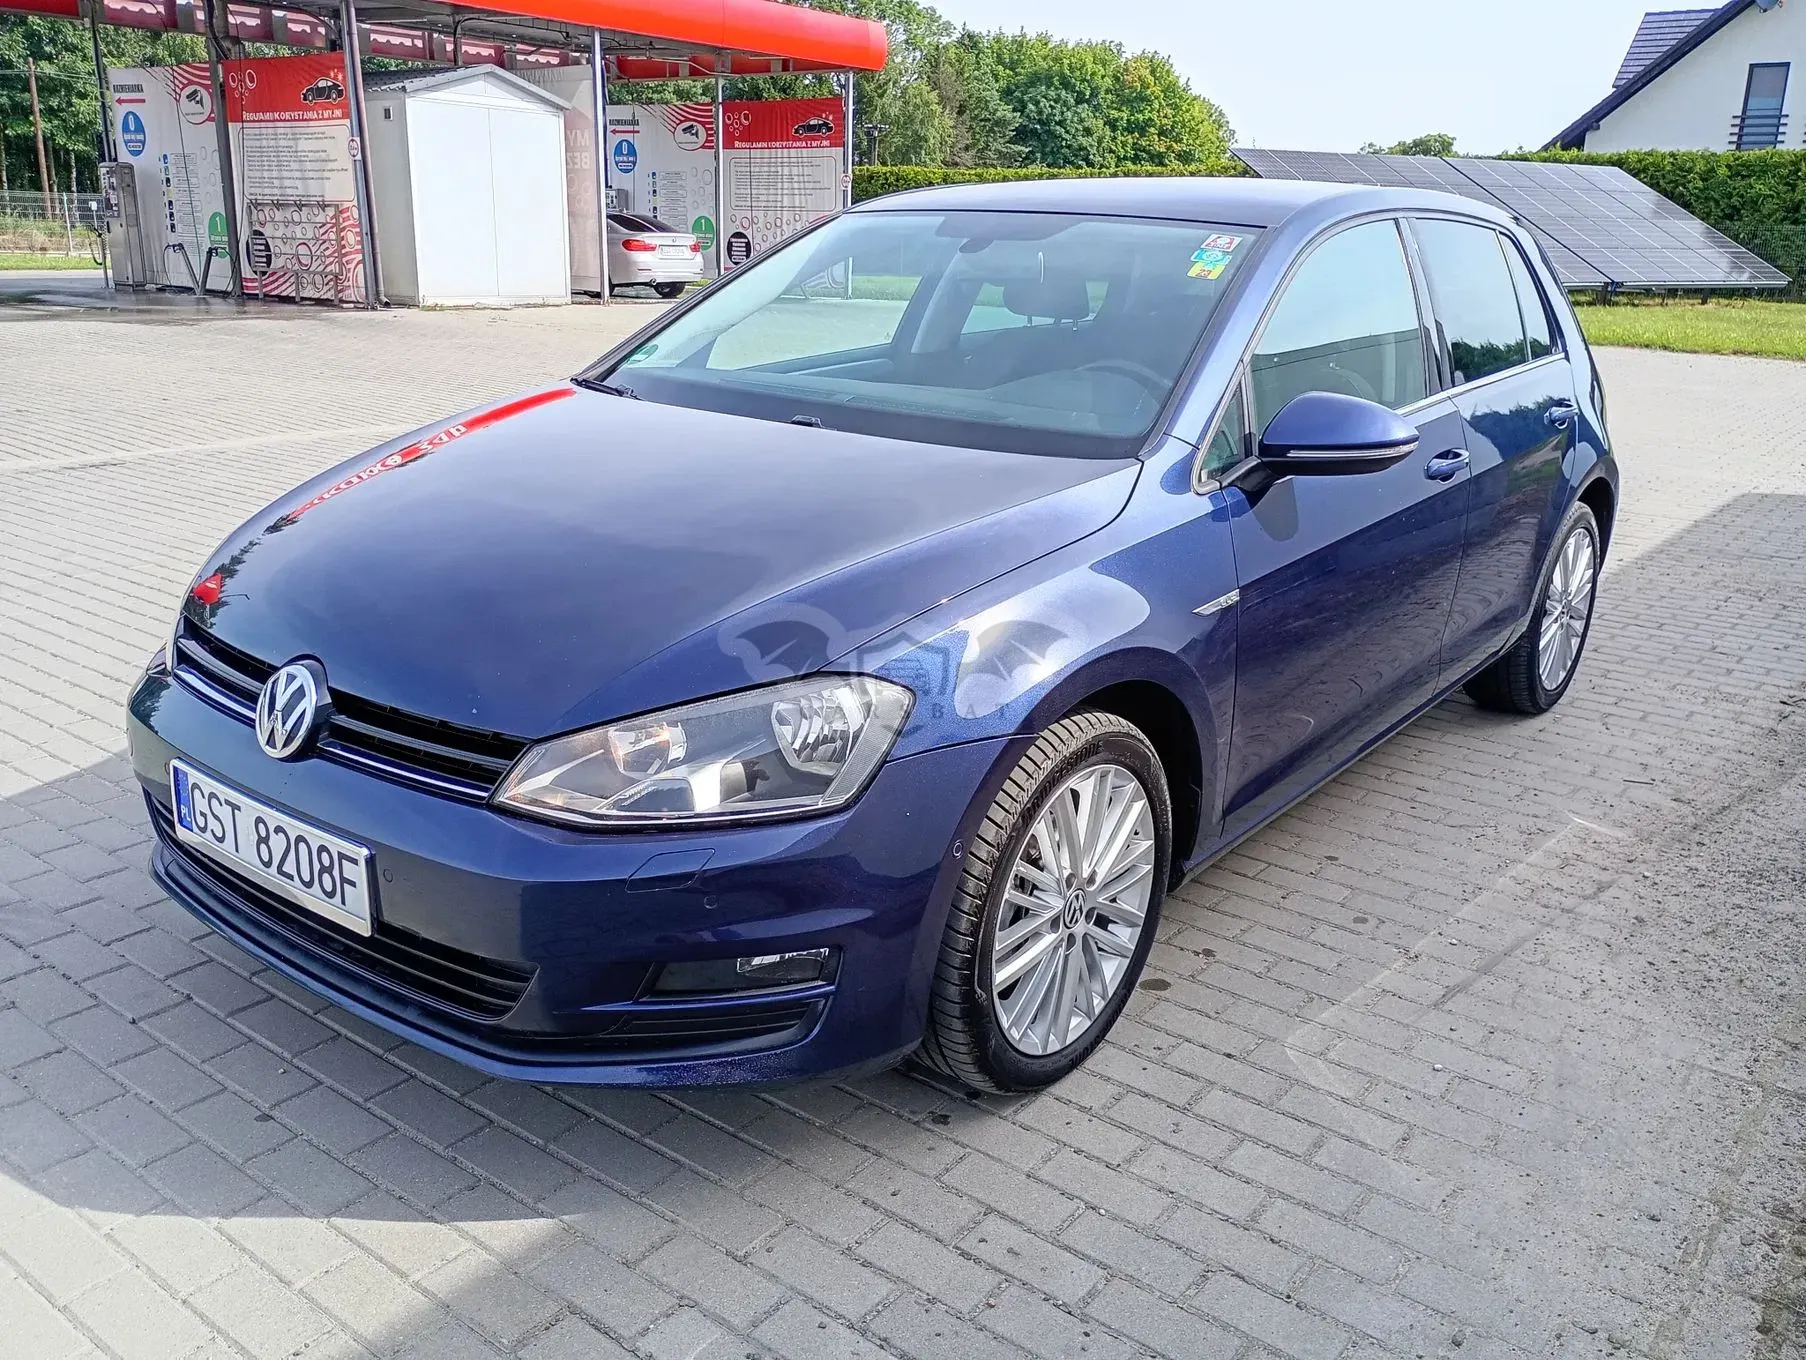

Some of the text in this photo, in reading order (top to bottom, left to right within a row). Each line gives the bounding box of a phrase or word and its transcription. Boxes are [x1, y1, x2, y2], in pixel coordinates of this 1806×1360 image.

[215, 216, 221, 232] 1
[700, 218, 706, 231] 1
[181, 804, 192, 822] PL
[190, 782, 359, 907] GST 8208F
